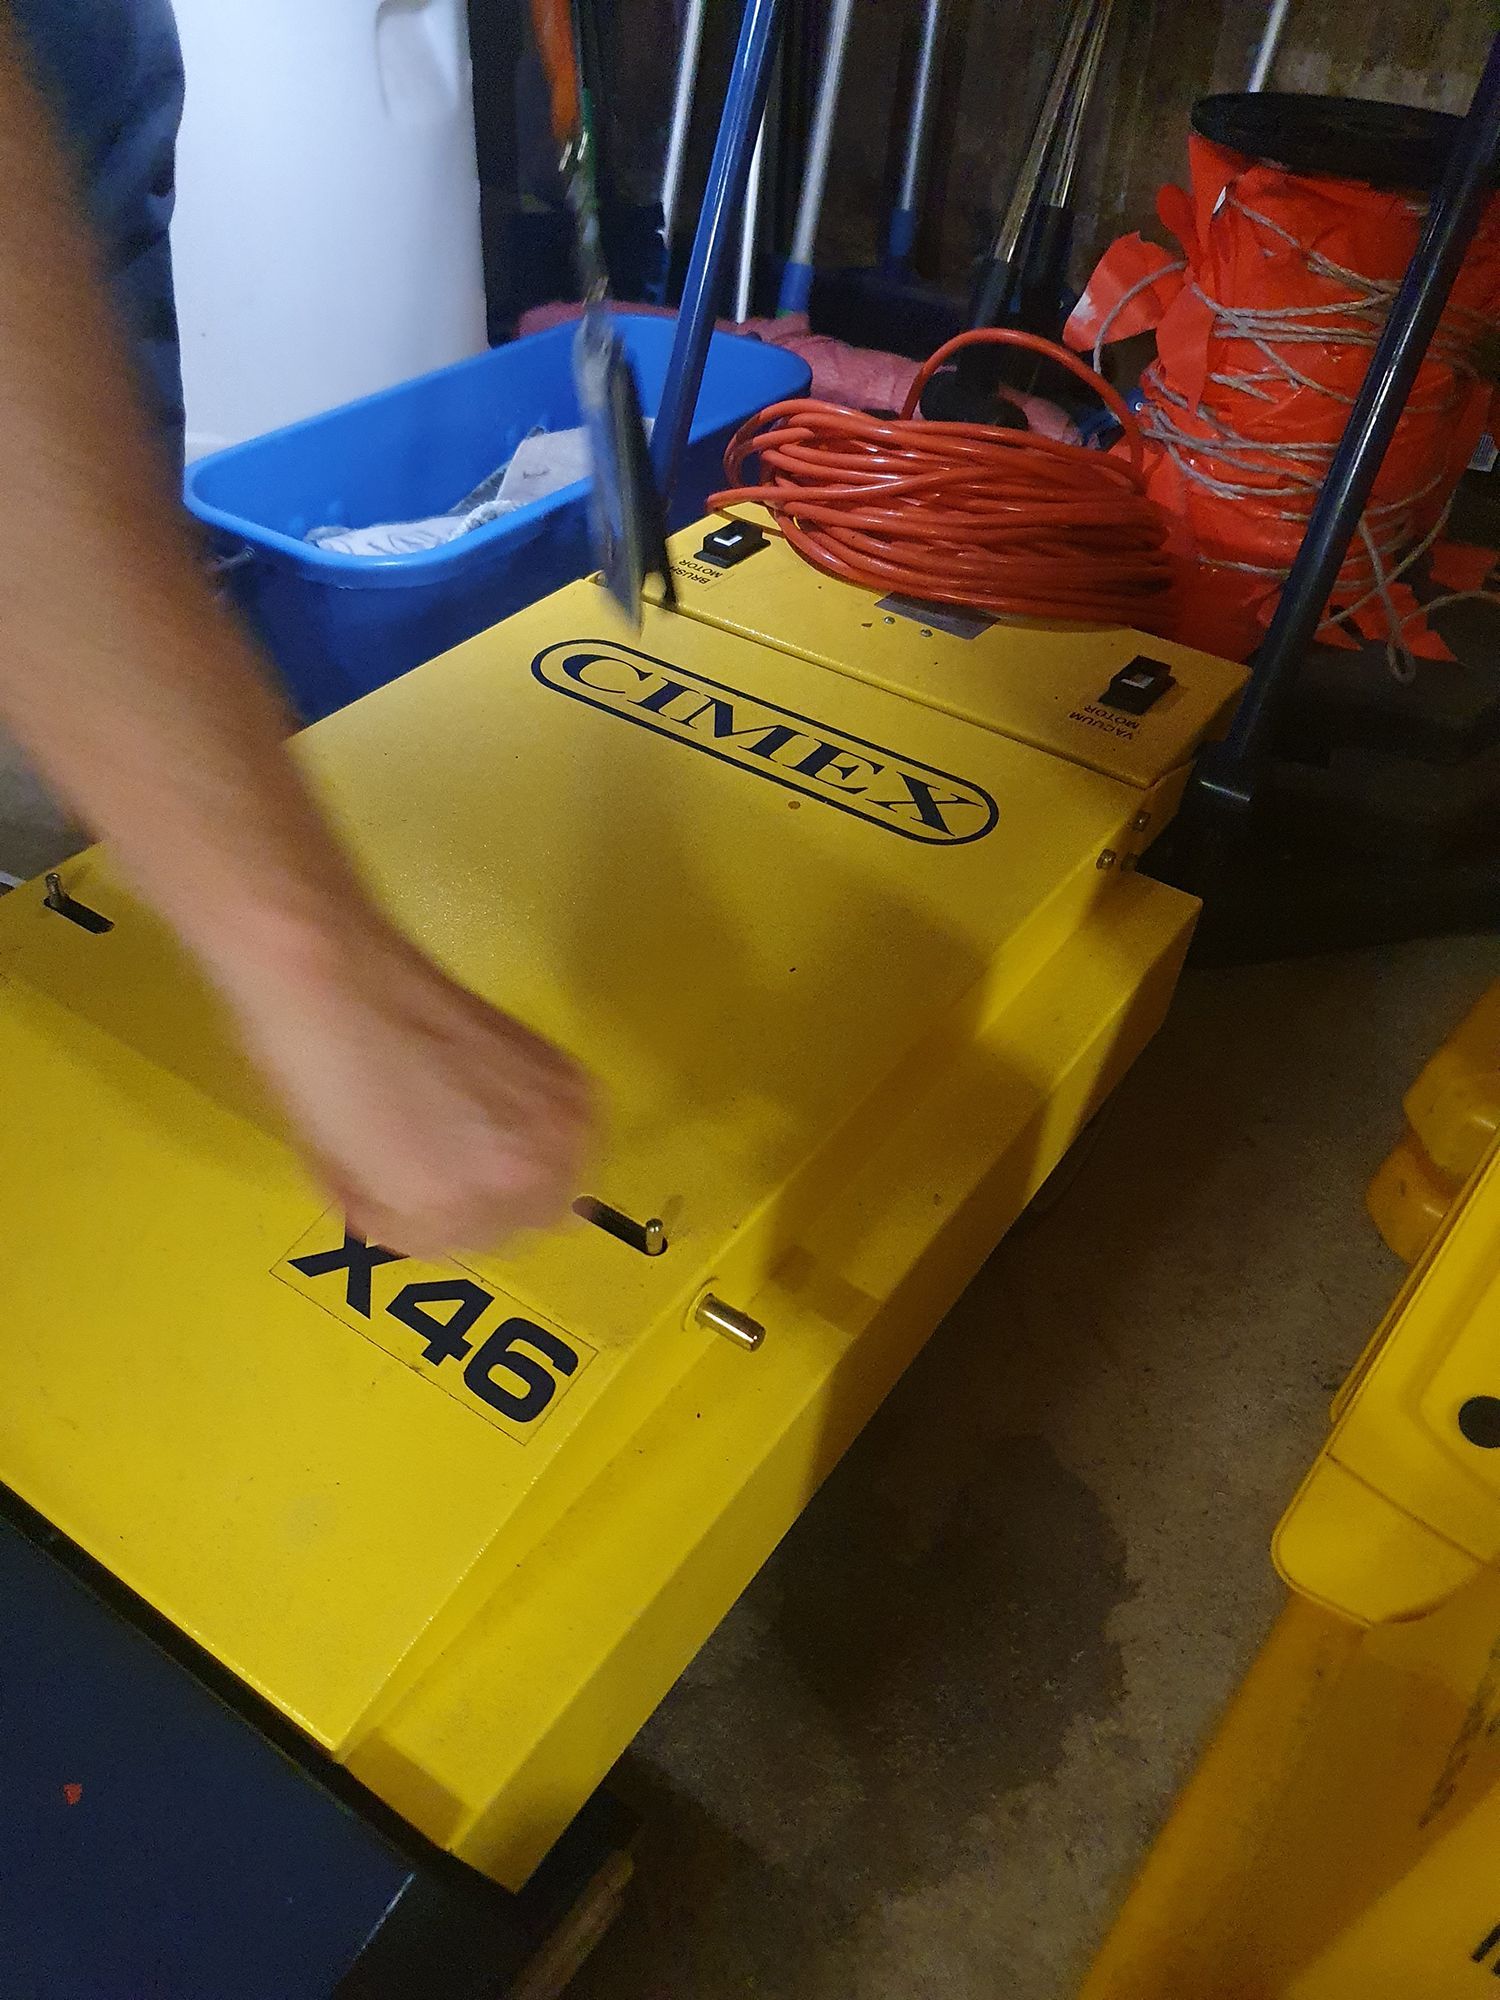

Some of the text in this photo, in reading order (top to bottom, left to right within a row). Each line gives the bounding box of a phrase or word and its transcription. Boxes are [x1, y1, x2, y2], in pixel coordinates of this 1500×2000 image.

[669, 566, 711, 584] BRUSH
[679, 559, 723, 578] MOTOR
[1069, 711, 1133, 740] VACUUM
[1083, 704, 1140, 730] MOTOR
[562, 653, 983, 837] CIMEX
[287, 1231, 579, 1423] X46
